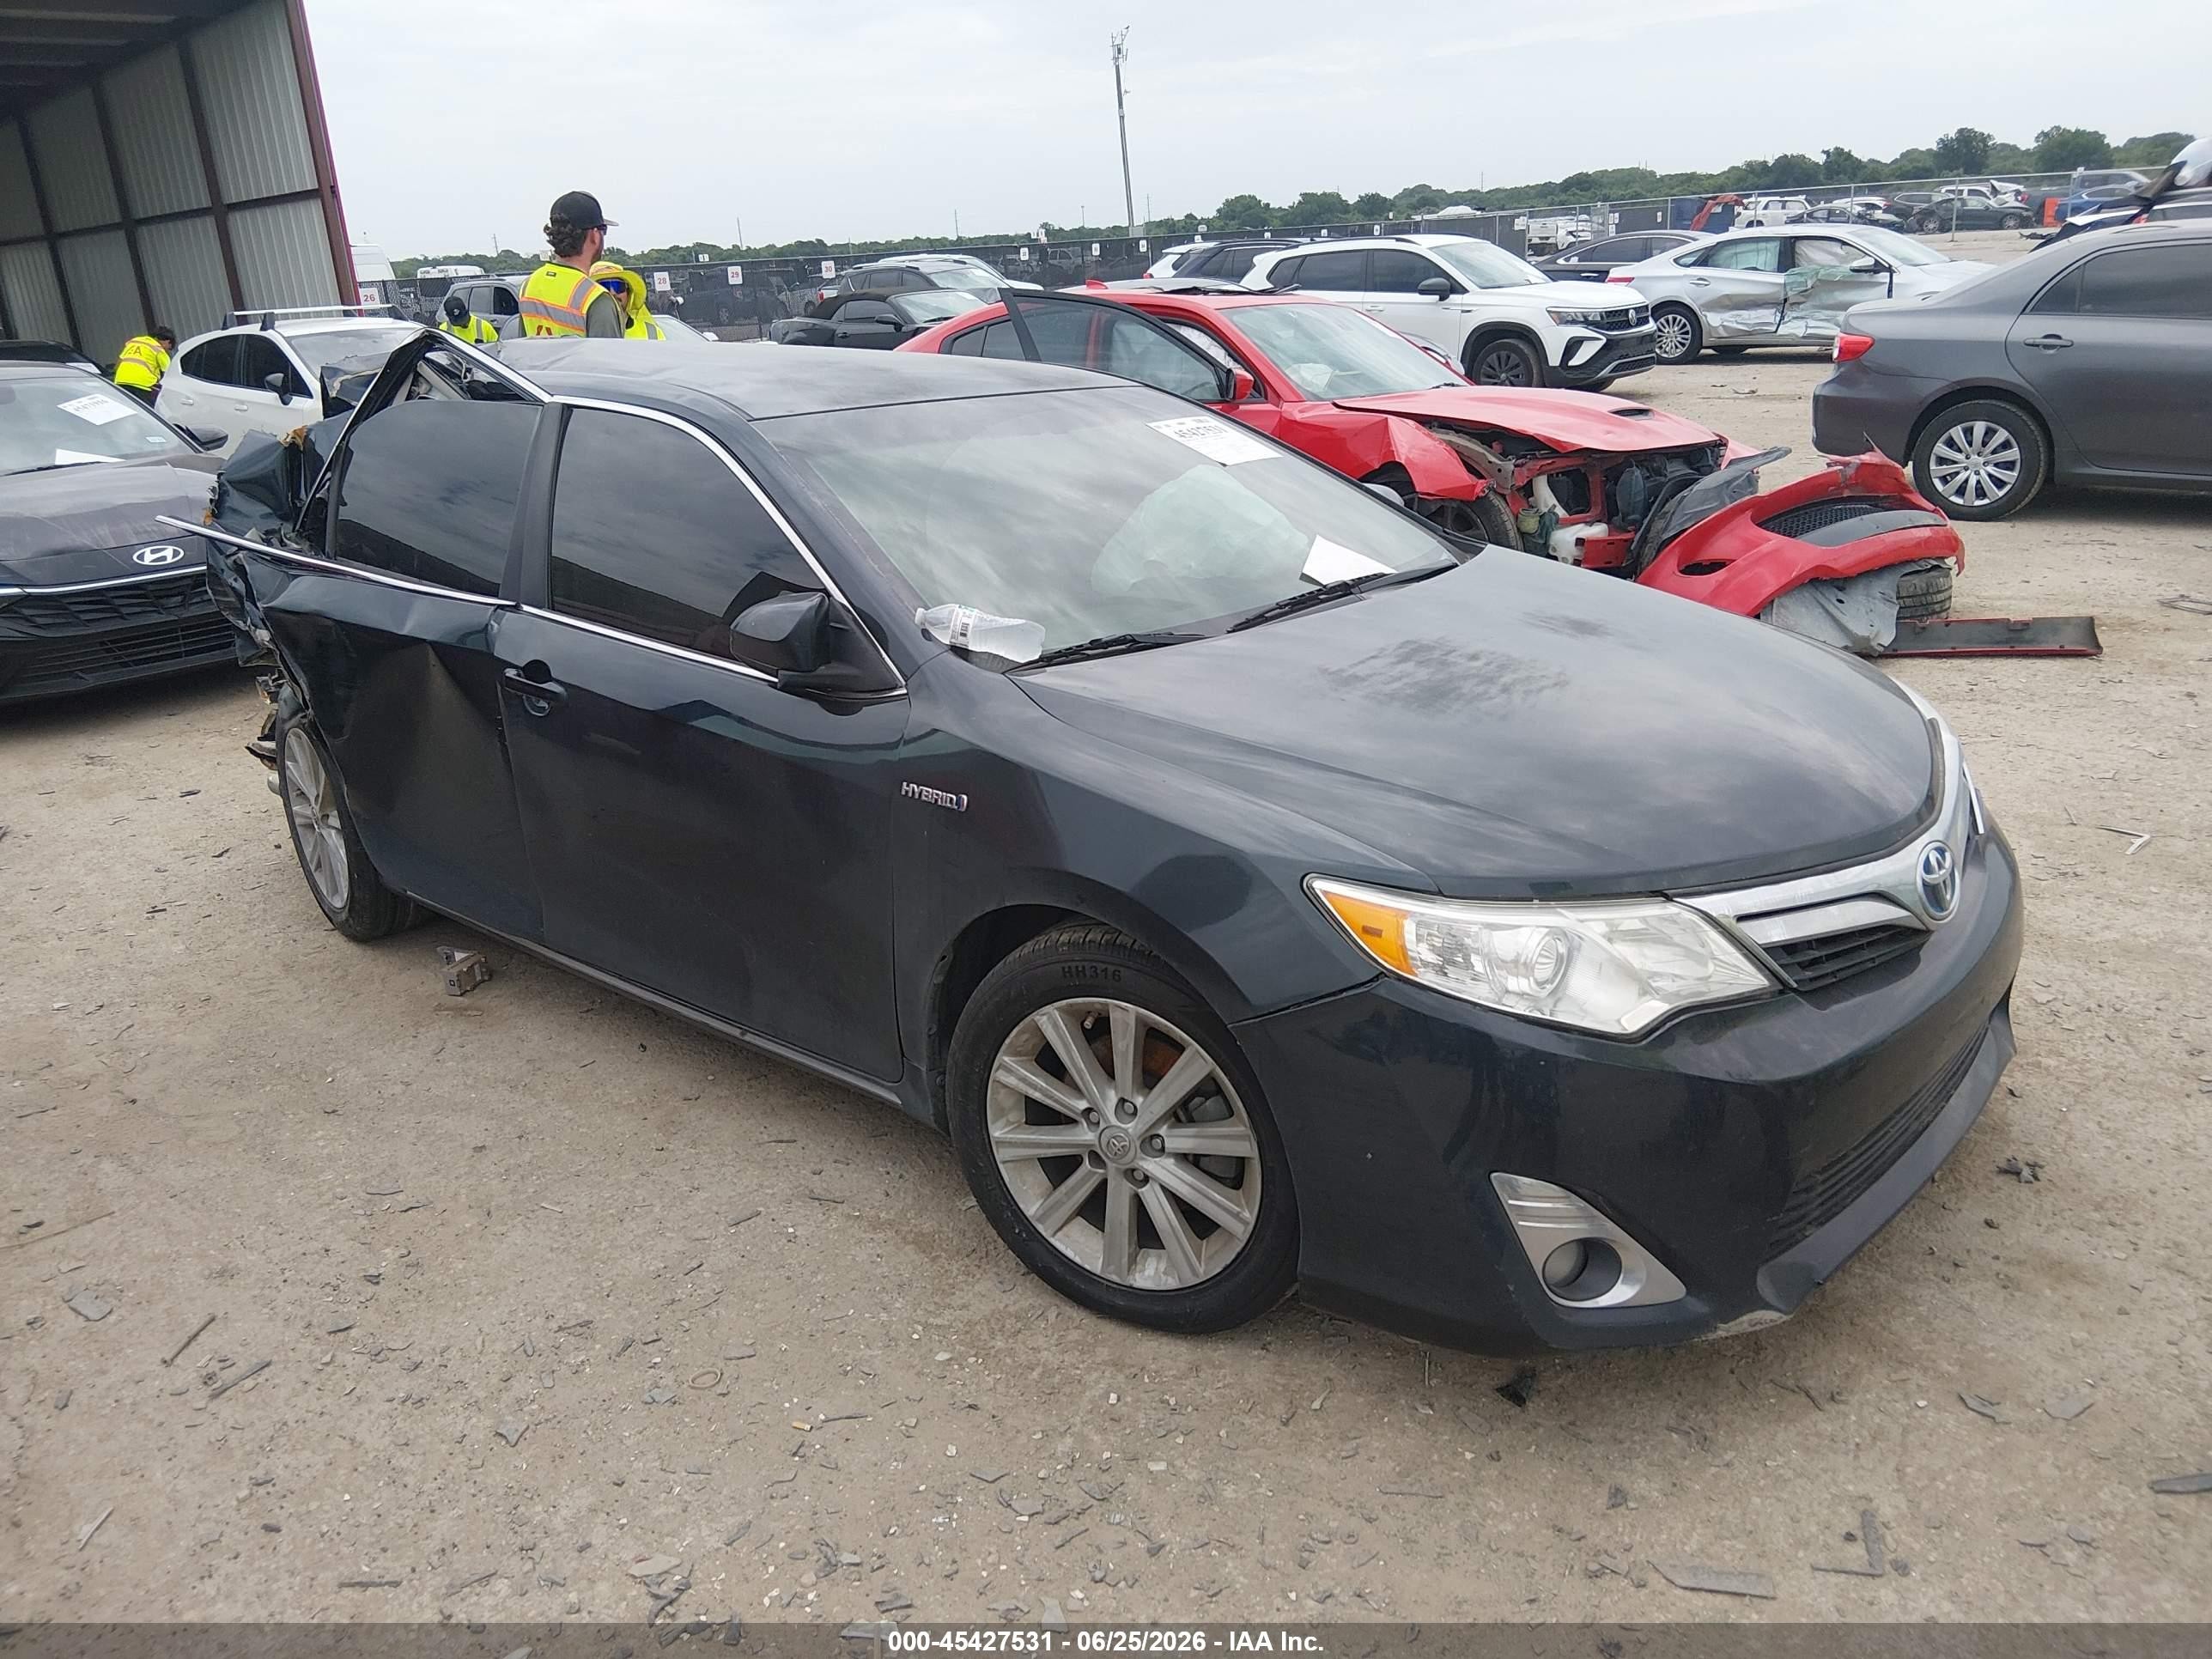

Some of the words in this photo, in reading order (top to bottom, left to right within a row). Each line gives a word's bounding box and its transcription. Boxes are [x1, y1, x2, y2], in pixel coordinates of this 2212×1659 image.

[363, 294, 376, 302] 26
[901, 781, 958, 810] HYBRID
[1061, 964, 1122, 983] HH316
